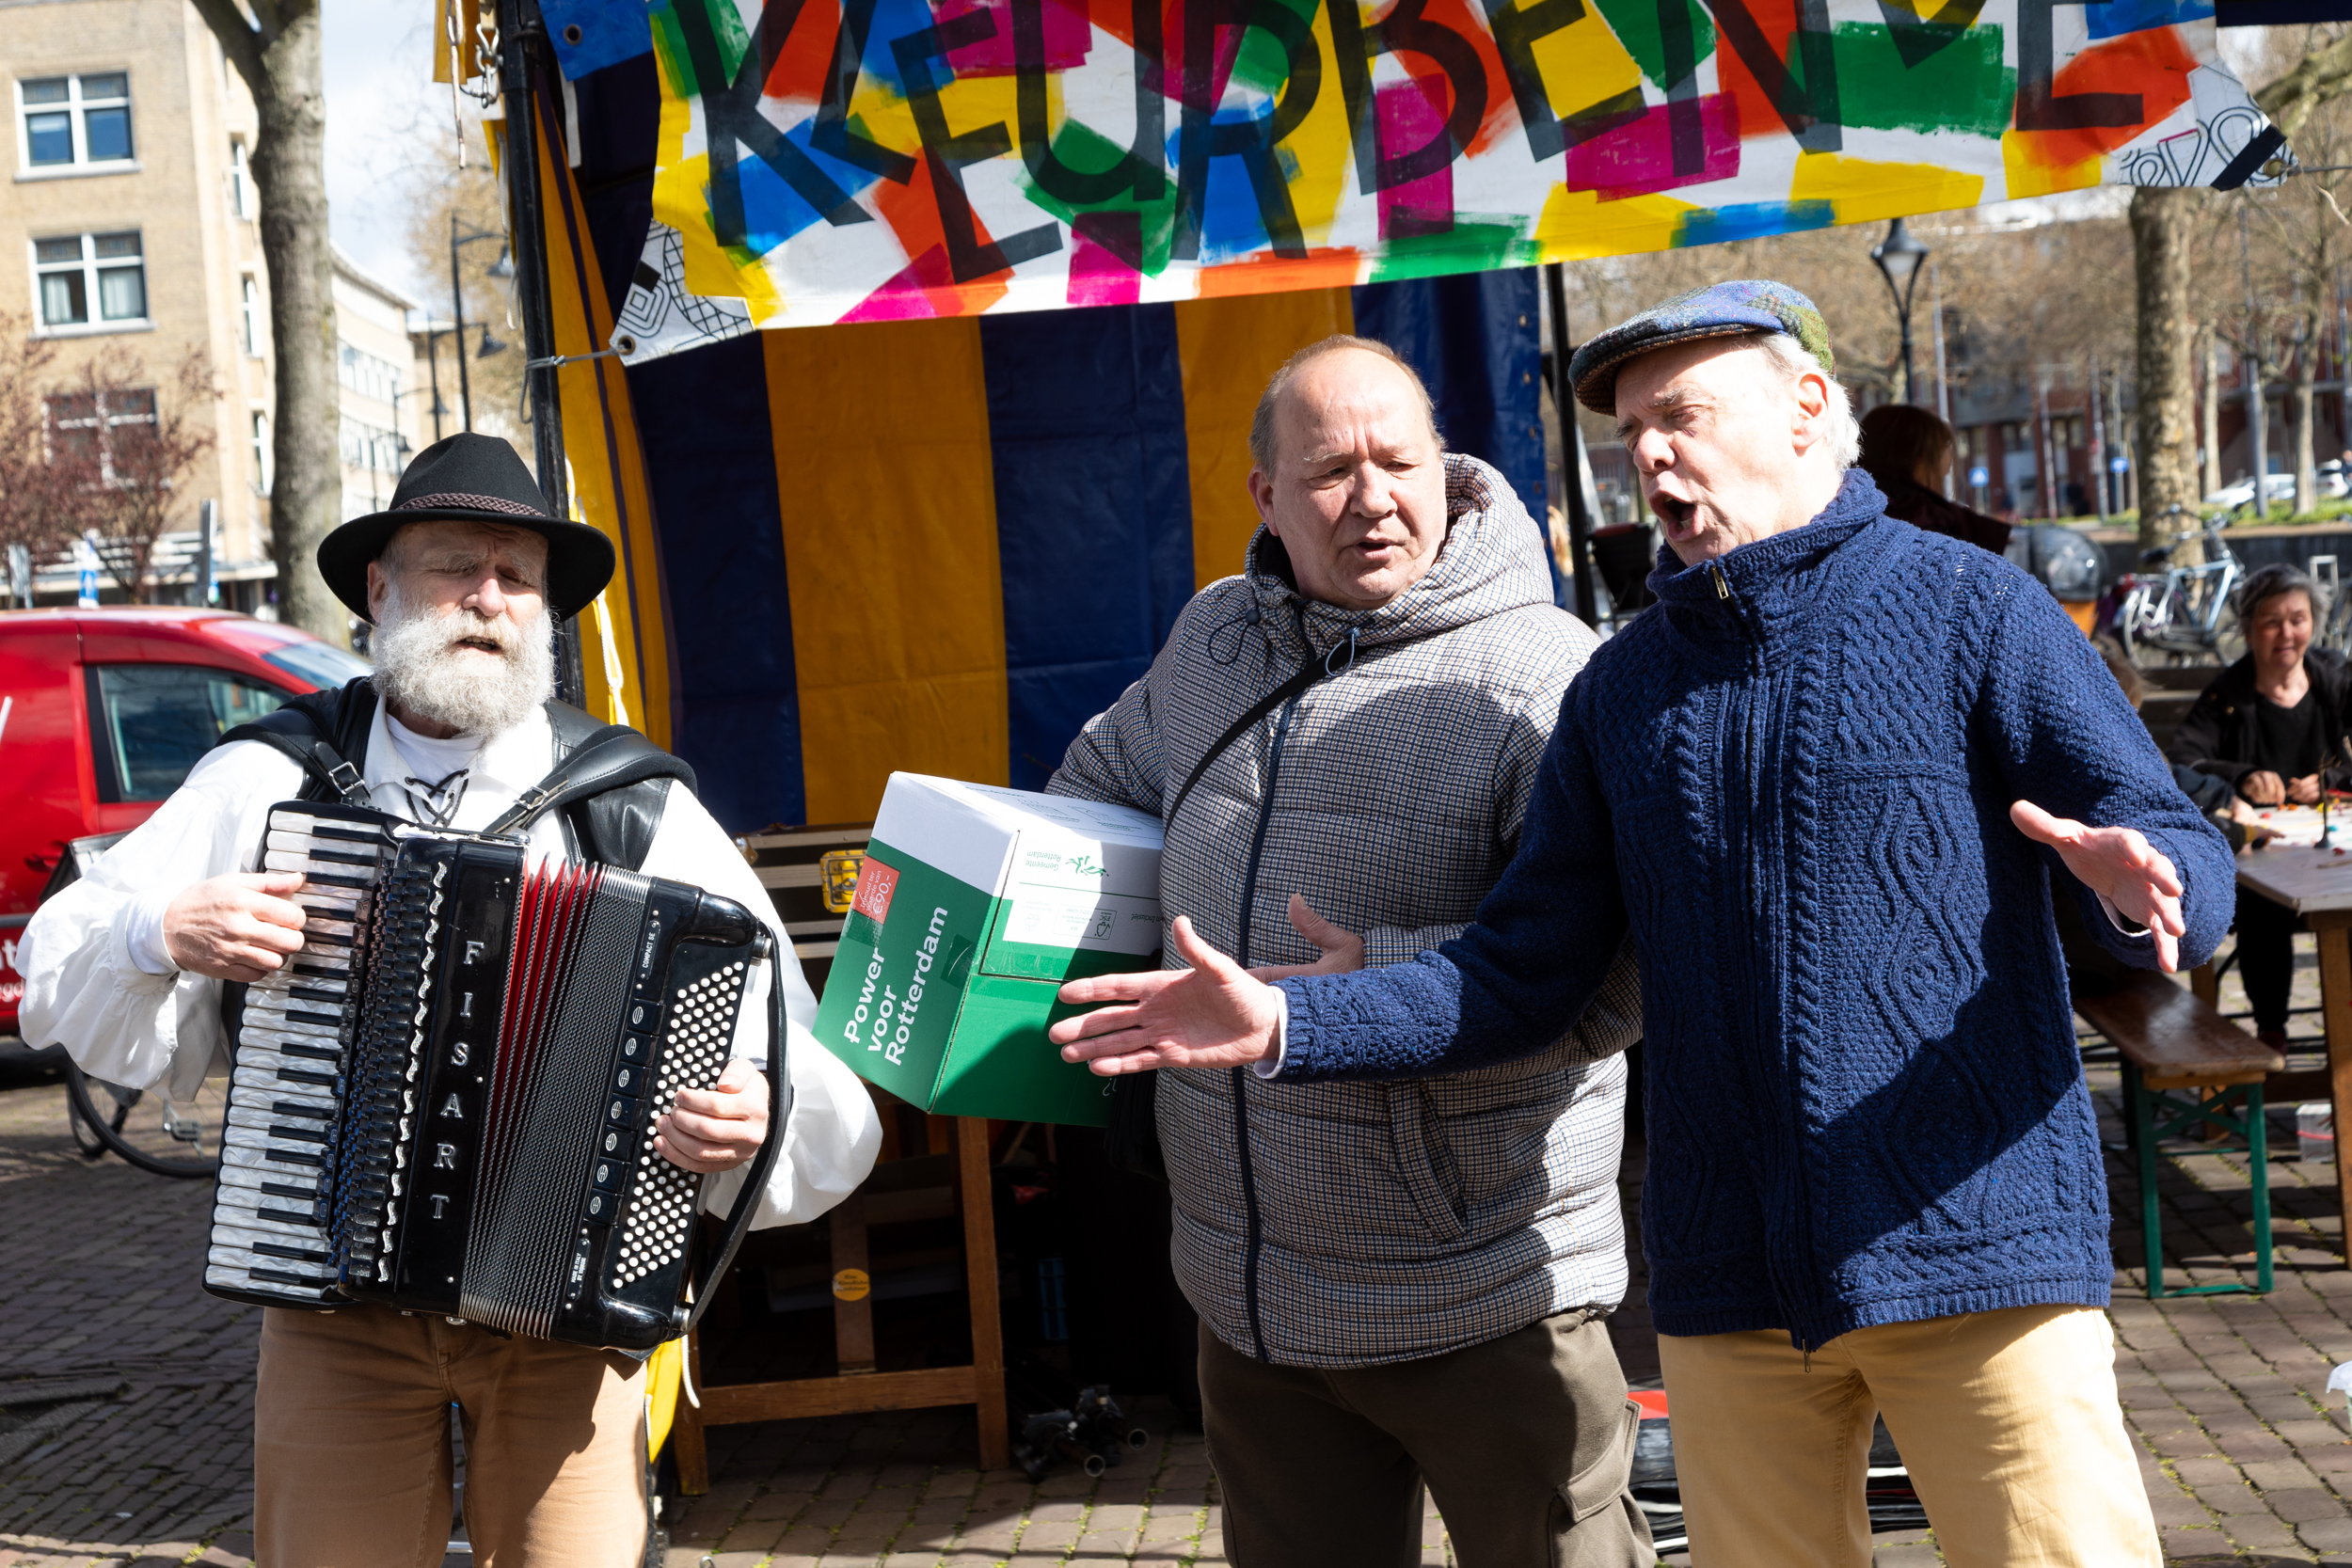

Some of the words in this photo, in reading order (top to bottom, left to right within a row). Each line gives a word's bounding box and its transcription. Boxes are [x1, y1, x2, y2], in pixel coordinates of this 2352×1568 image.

[1025, 858, 1059, 871] Gemeente
[1026, 849, 1062, 862] Rotterdam
[859, 881, 872, 910] Inhoud
[647, 931, 656, 941] SE
[642, 942, 654, 969] COMPACT
[843, 946, 885, 1044] Power
[884, 906, 949, 1066] Rotterdam
[867, 984, 898, 1053] voor
[430, 942, 485, 1220] FISART
